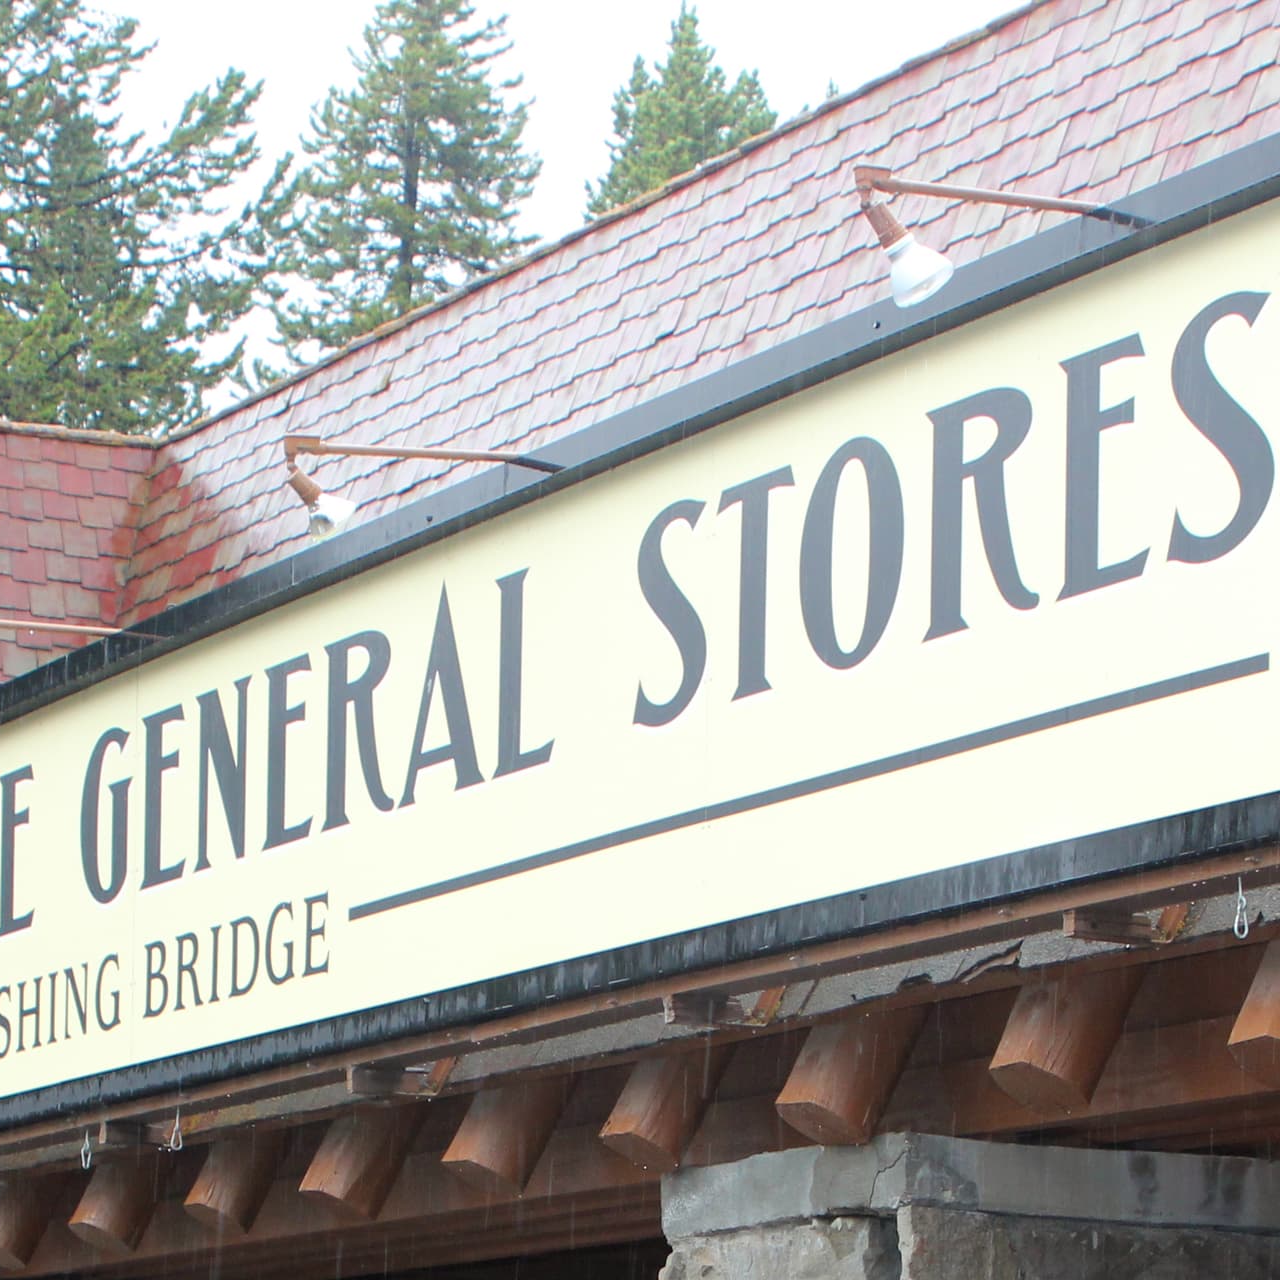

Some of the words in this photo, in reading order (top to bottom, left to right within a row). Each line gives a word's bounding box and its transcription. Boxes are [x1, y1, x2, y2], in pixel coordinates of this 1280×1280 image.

[78, 567, 556, 905] GENERAL
[633, 290, 1275, 728] STORES
[142, 891, 331, 1020] BRIDGE
